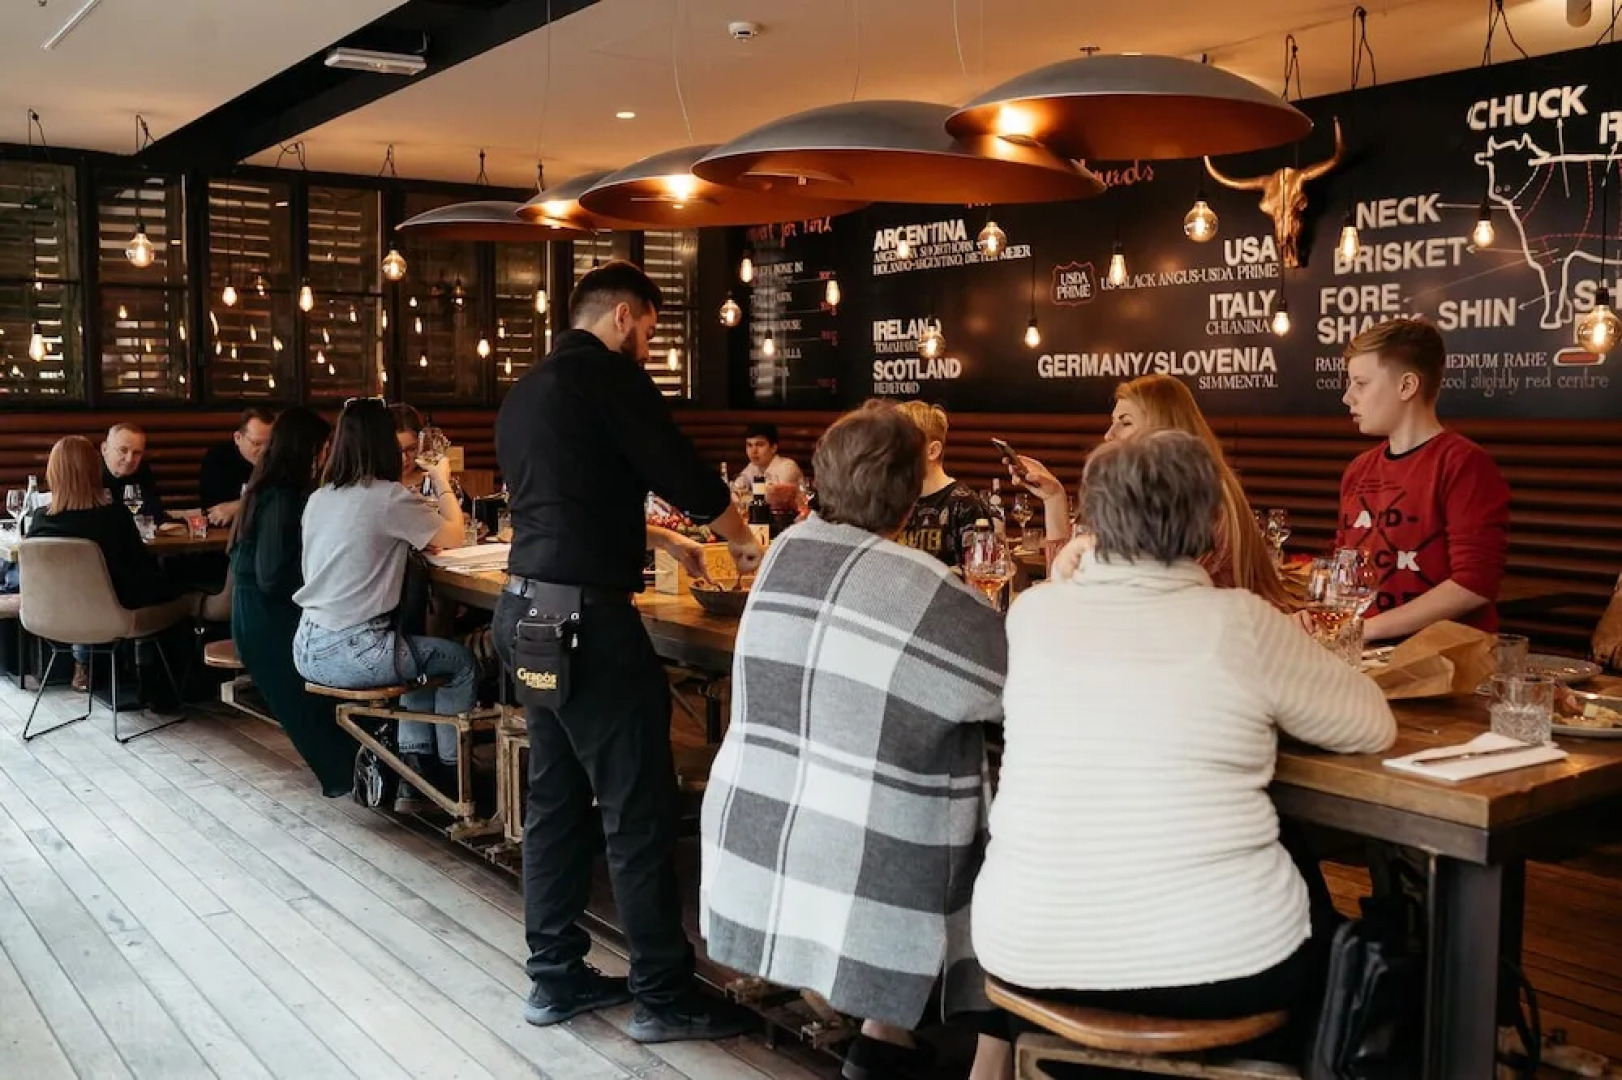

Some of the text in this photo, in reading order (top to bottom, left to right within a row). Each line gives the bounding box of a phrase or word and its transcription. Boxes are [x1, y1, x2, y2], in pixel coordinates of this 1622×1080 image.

[1466, 84, 1588, 131] CHUCK
[1355, 192, 1441, 230] NECK
[1224, 235, 1278, 266] USA
[1333, 236, 1467, 275] BRISKET
[1237, 262, 1279, 281] PRIME
[1057, 284, 1091, 299] PRIME
[1209, 289, 1277, 320] ITALY
[1320, 284, 1400, 315] FORE
[1206, 319, 1272, 335] CHIANINA
[1317, 313, 1424, 345] SHA
[1437, 297, 1516, 331] SHIN
[873, 358, 962, 380] SCOTLAND
[1038, 346, 1278, 379] GERMANY/SLOVENIA
[1504, 352, 1547, 367] RARE
[1199, 372, 1278, 391] SIMMENTAL
[1471, 366, 1520, 398] slightly
[1525, 366, 1551, 389] red
[1557, 366, 1609, 389] centre
